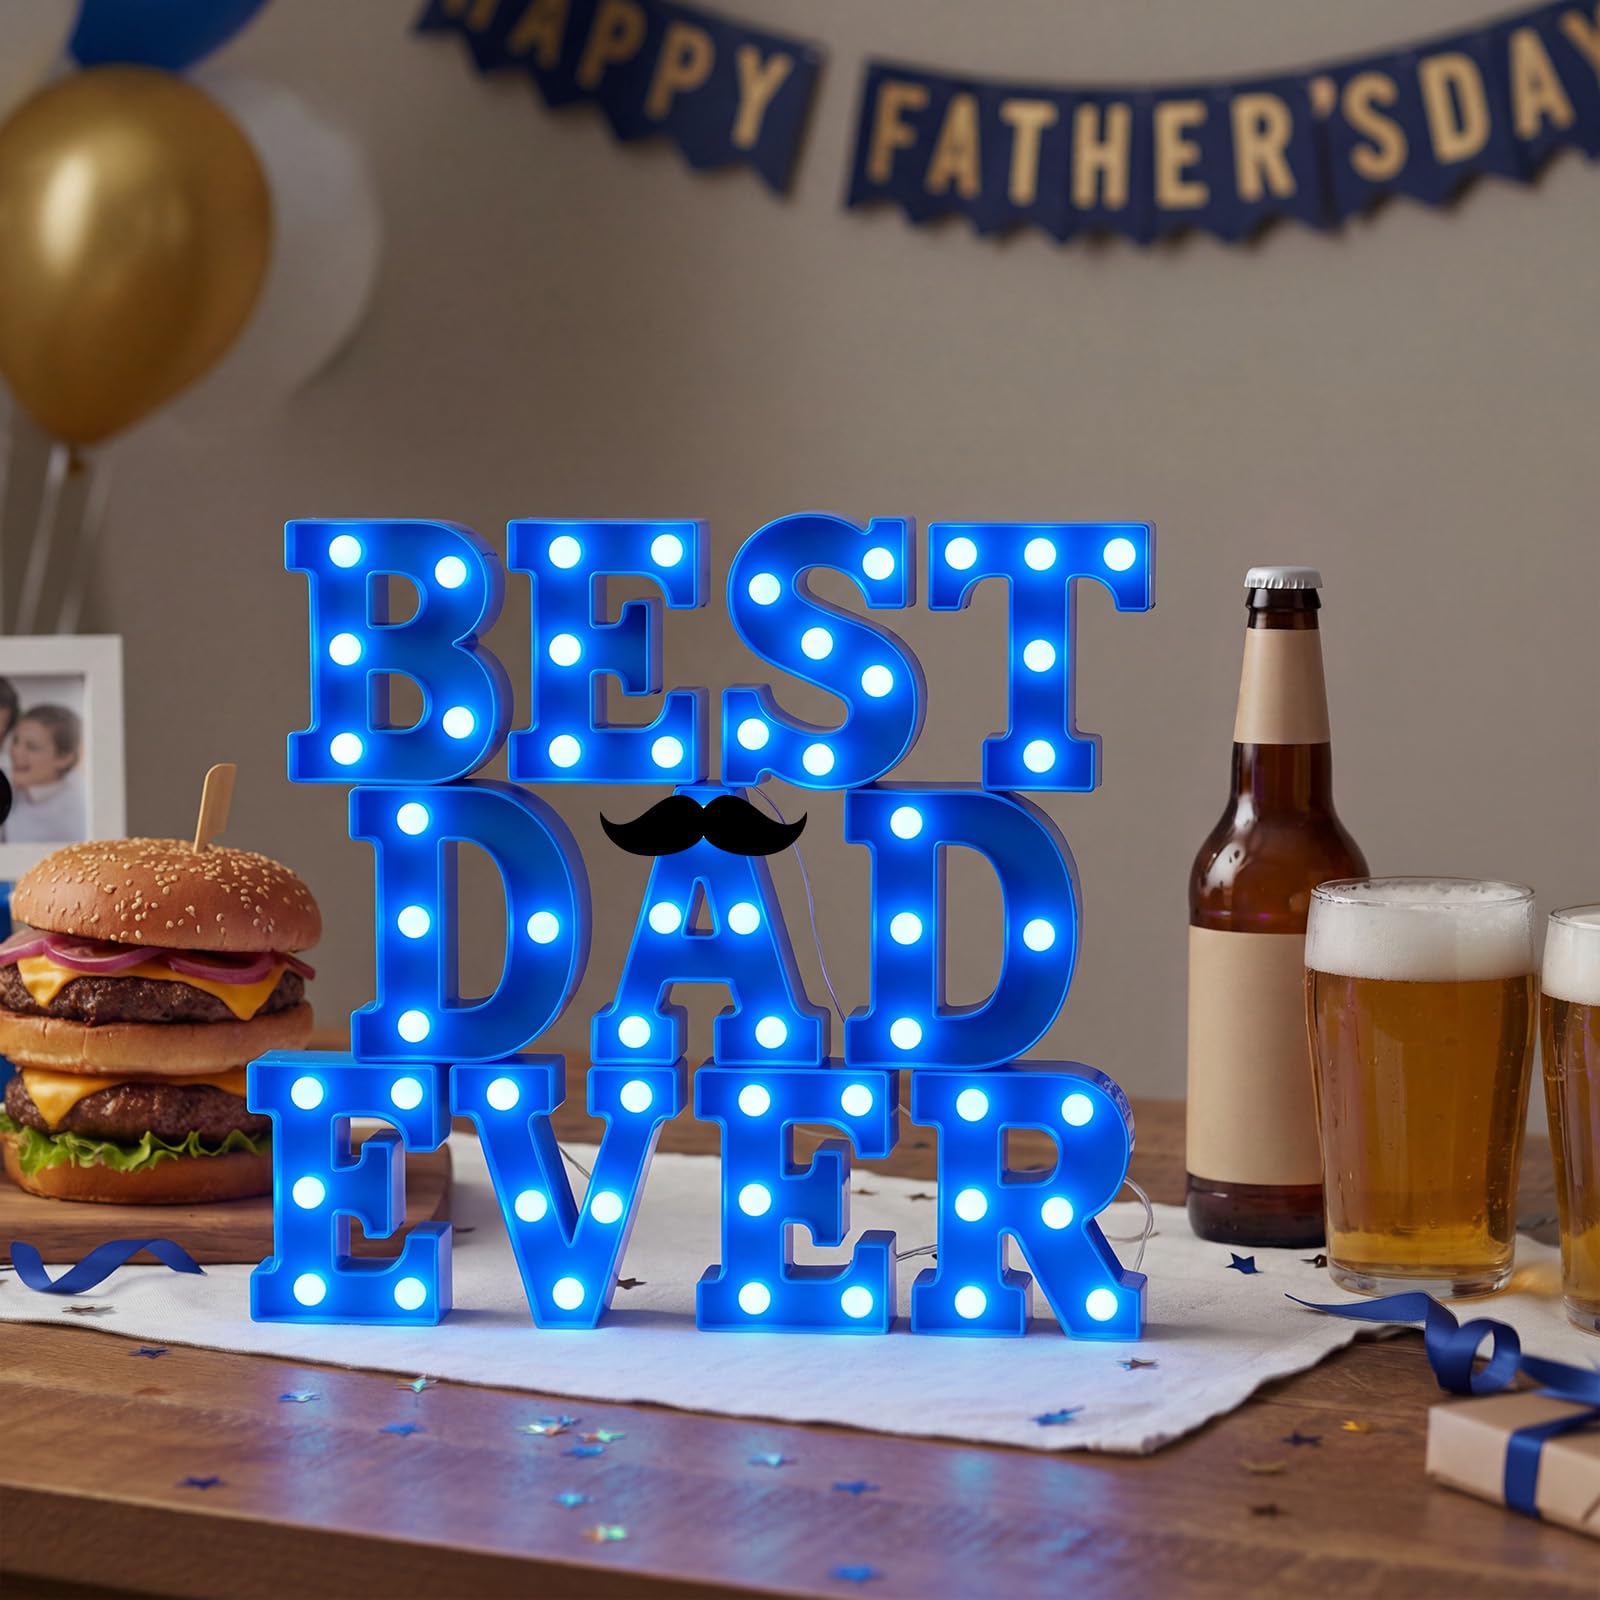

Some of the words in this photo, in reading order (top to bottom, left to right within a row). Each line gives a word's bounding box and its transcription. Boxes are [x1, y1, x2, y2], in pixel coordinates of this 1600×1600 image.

[284, 511, 1156, 793] BEST
[348, 779, 1083, 1071] DAD
[247, 1049, 1148, 1342] EVER
